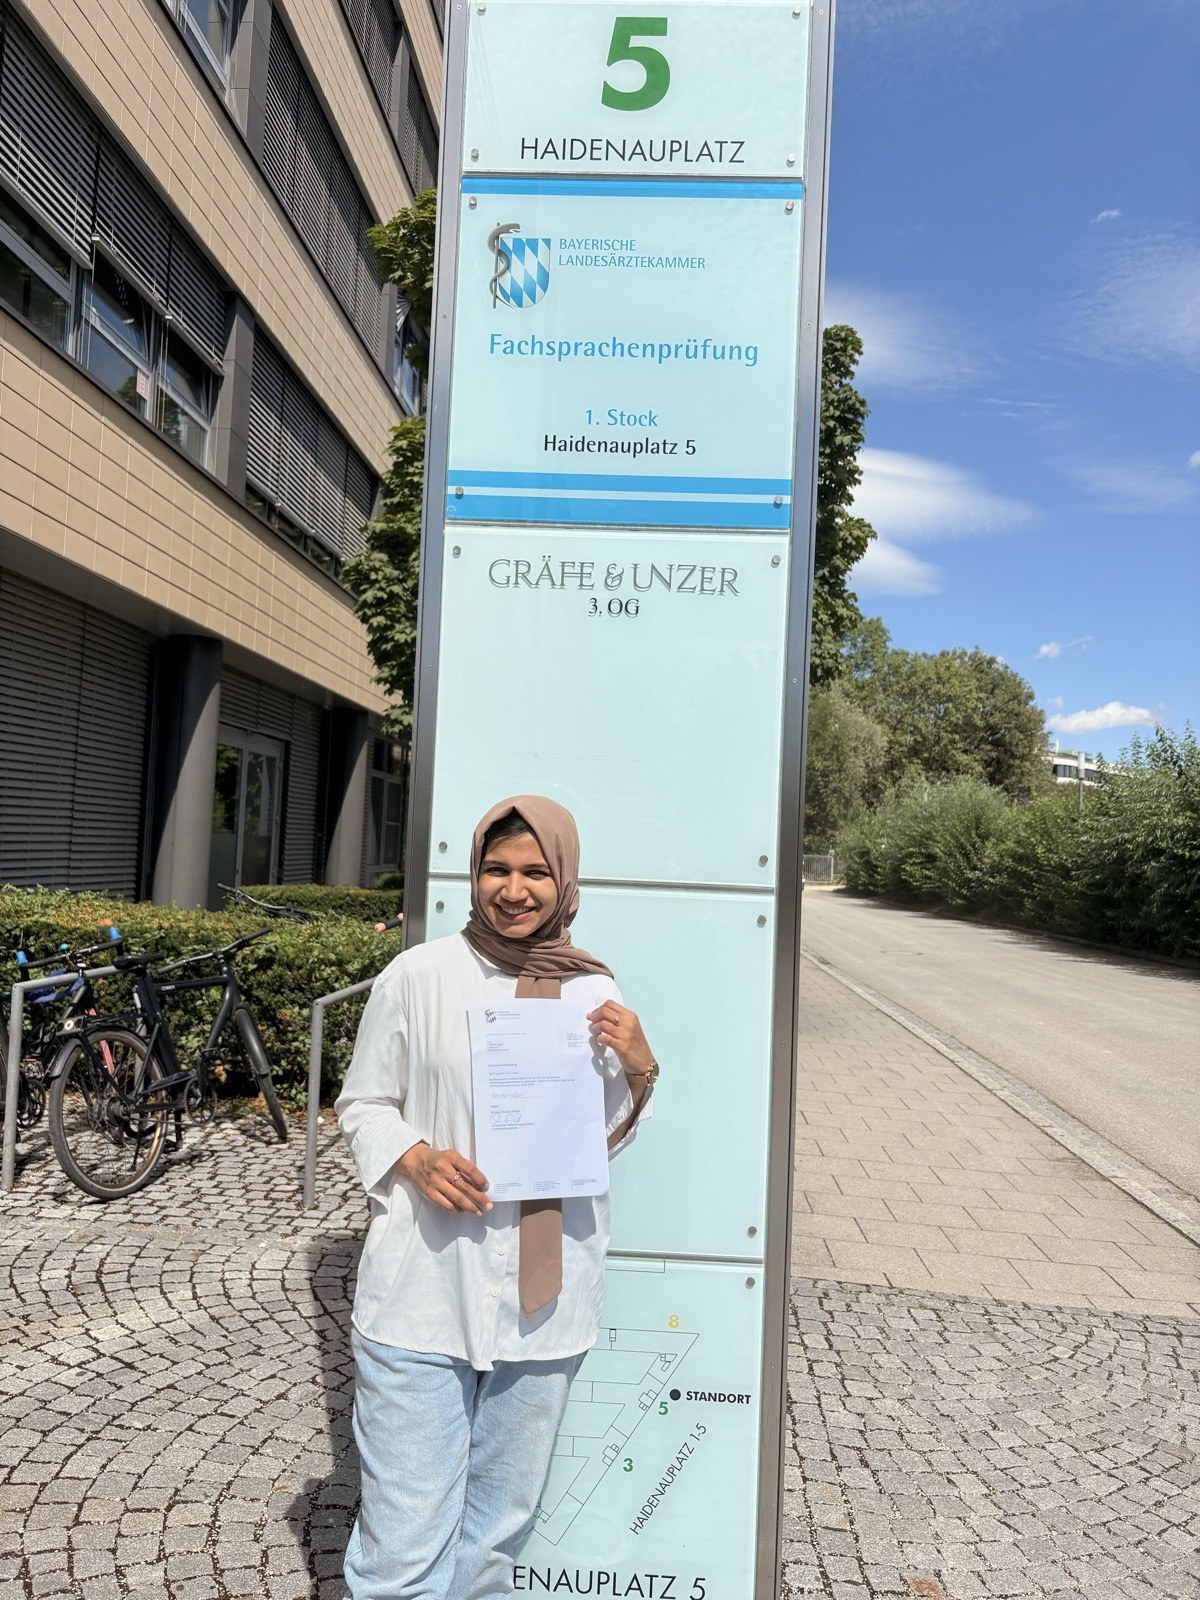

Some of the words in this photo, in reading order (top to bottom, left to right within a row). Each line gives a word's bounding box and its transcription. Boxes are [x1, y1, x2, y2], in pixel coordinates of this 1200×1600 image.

[600, 16, 671, 112] 5
[520, 137, 745, 163] HAIDENAUPLATZ
[559, 238, 636, 251] BAYERISCHE
[558, 253, 706, 269] LANDESÄRZTEKAMMER
[489, 333, 759, 367] Fachsprachenprüfung
[585, 409, 600, 425] 1.
[607, 409, 658, 427] Stock
[543, 434, 678, 458] Haidenauplatz
[685, 439, 697, 456] 5
[488, 555, 595, 590] GRÄFE
[604, 563, 625, 591] &
[633, 563, 741, 597] UNZER
[588, 597, 603, 617] 3.
[607, 598, 640, 618] OG
[668, 1314, 680, 1329] 8
[686, 1390, 751, 1405] STANDORT
[658, 1401, 669, 1416] 5
[622, 1458, 634, 1473] 3
[629, 1442, 695, 1535] HAIDENAUPLATZ
[689, 1422, 707, 1442] 1-5
[513, 1565, 677, 1600] ENAUPLATZ
[689, 1577, 706, 1600] 5
